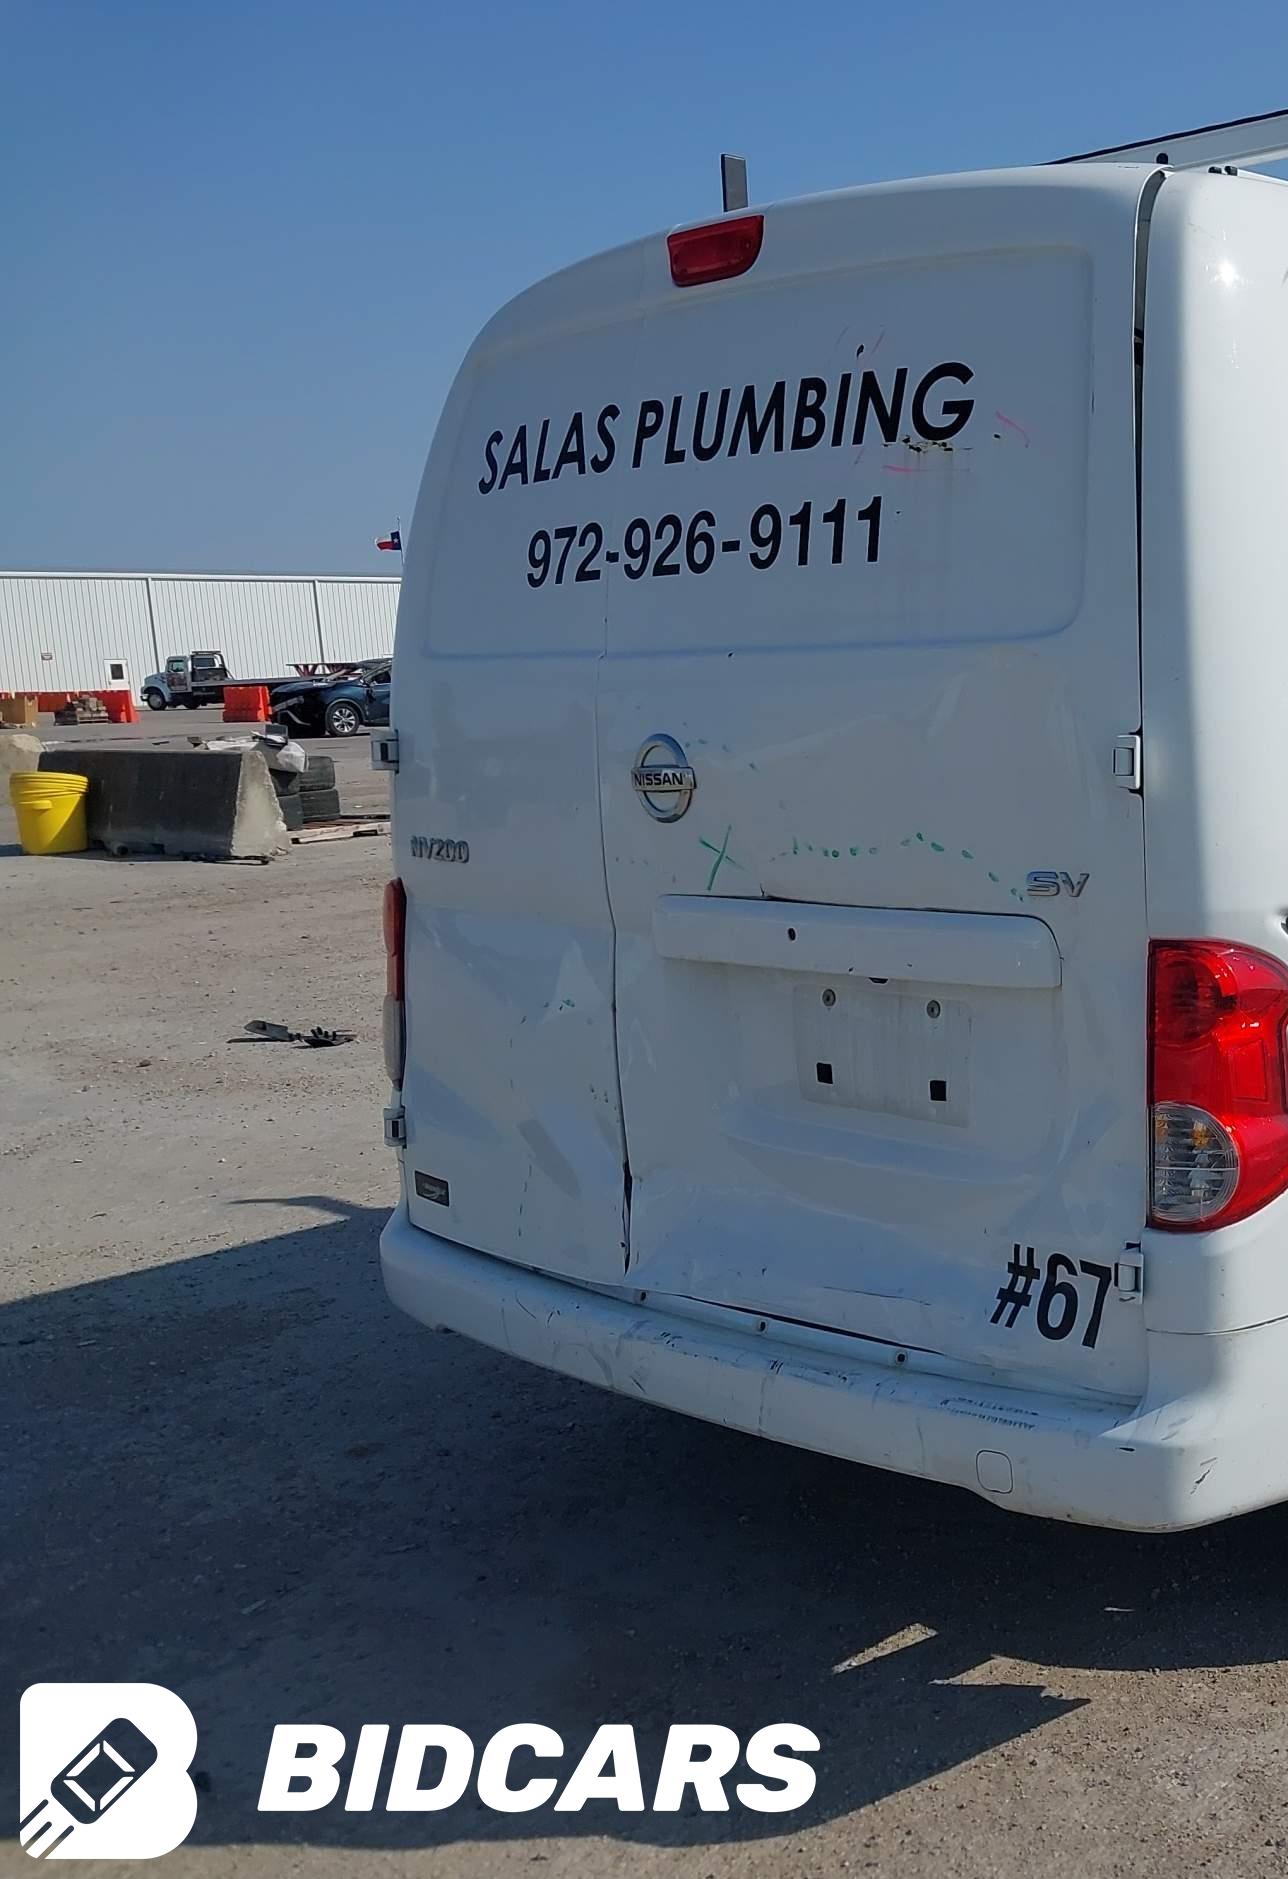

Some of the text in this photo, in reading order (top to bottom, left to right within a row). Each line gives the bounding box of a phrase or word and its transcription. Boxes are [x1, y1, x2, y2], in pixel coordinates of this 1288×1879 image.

[479, 361, 975, 495] SALAS PLUMBING
[526, 496, 883, 588] 972-926-9111
[633, 771, 684, 787] NISSAN
[410, 834, 470, 864] NV200
[1026, 870, 1090, 898] SV
[990, 1243, 1113, 1349] #67
